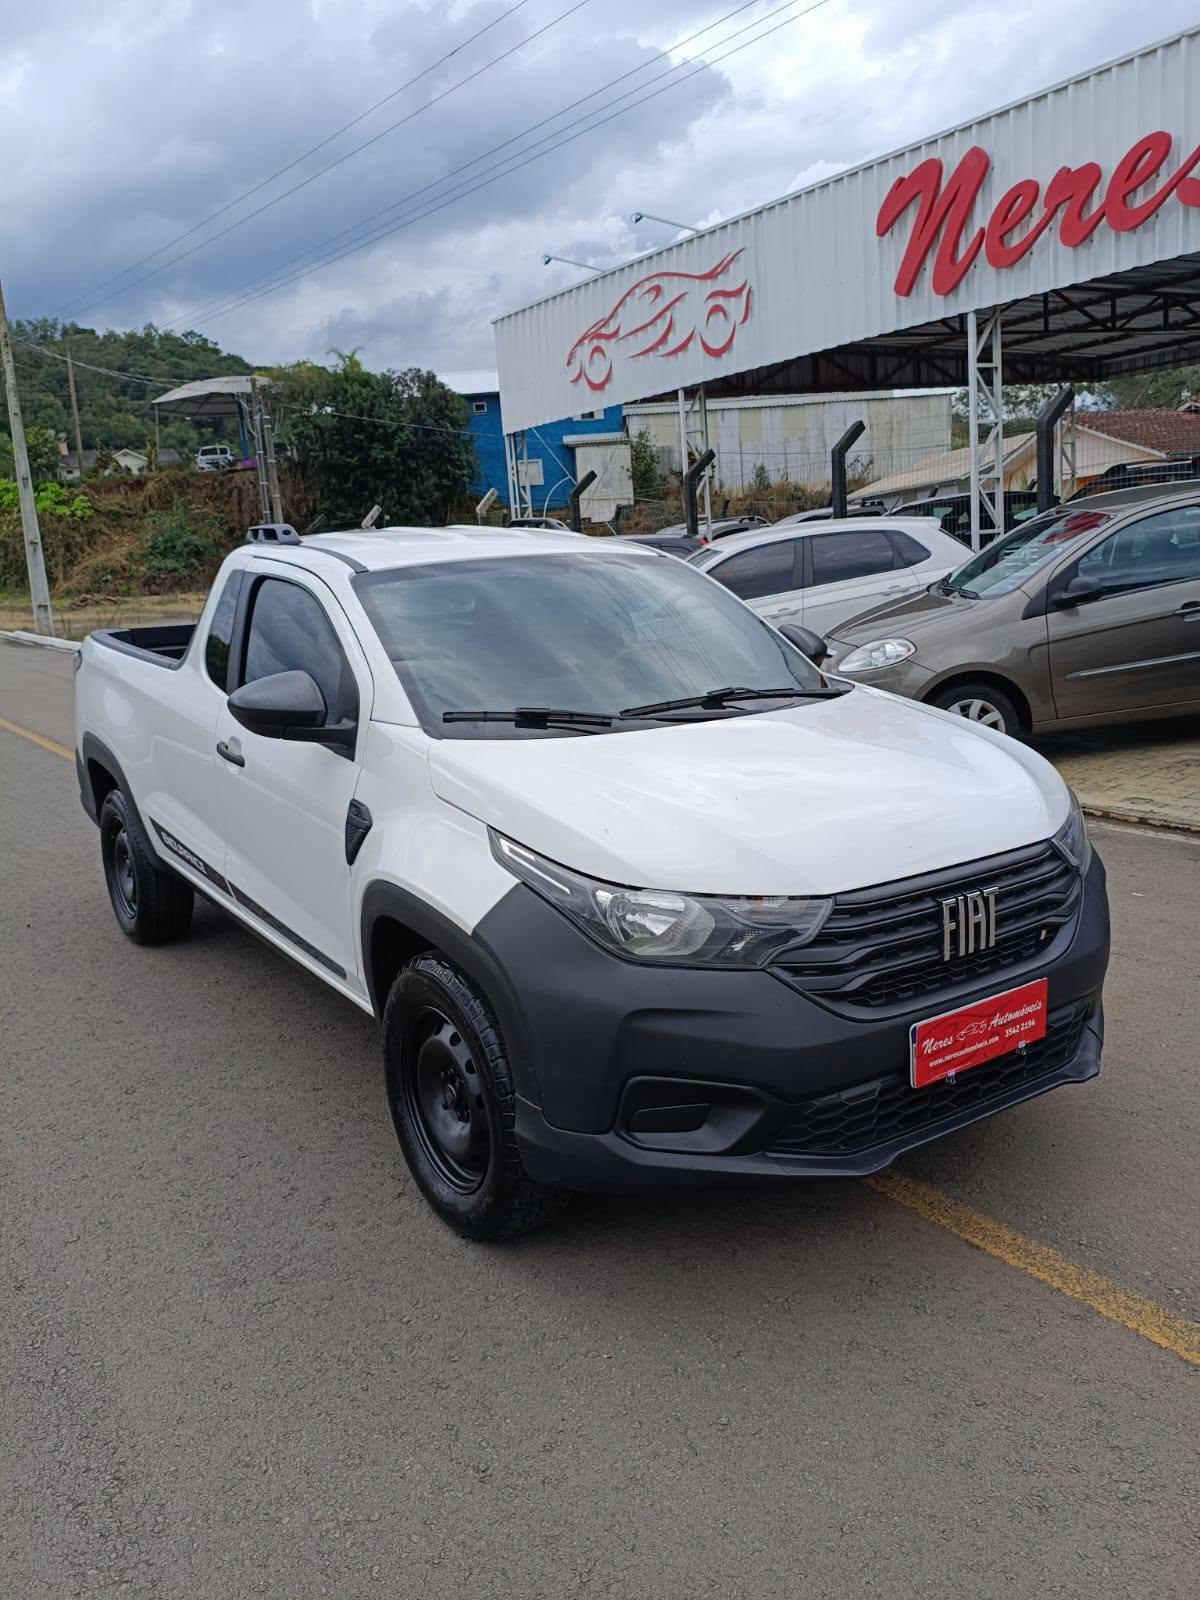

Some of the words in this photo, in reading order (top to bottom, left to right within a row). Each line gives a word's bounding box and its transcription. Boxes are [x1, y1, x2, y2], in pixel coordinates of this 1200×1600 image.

[941, 886, 999, 961] FIAT
[1005, 1024, 1020, 1038] 3542
[922, 1035, 954, 1055] Neres
